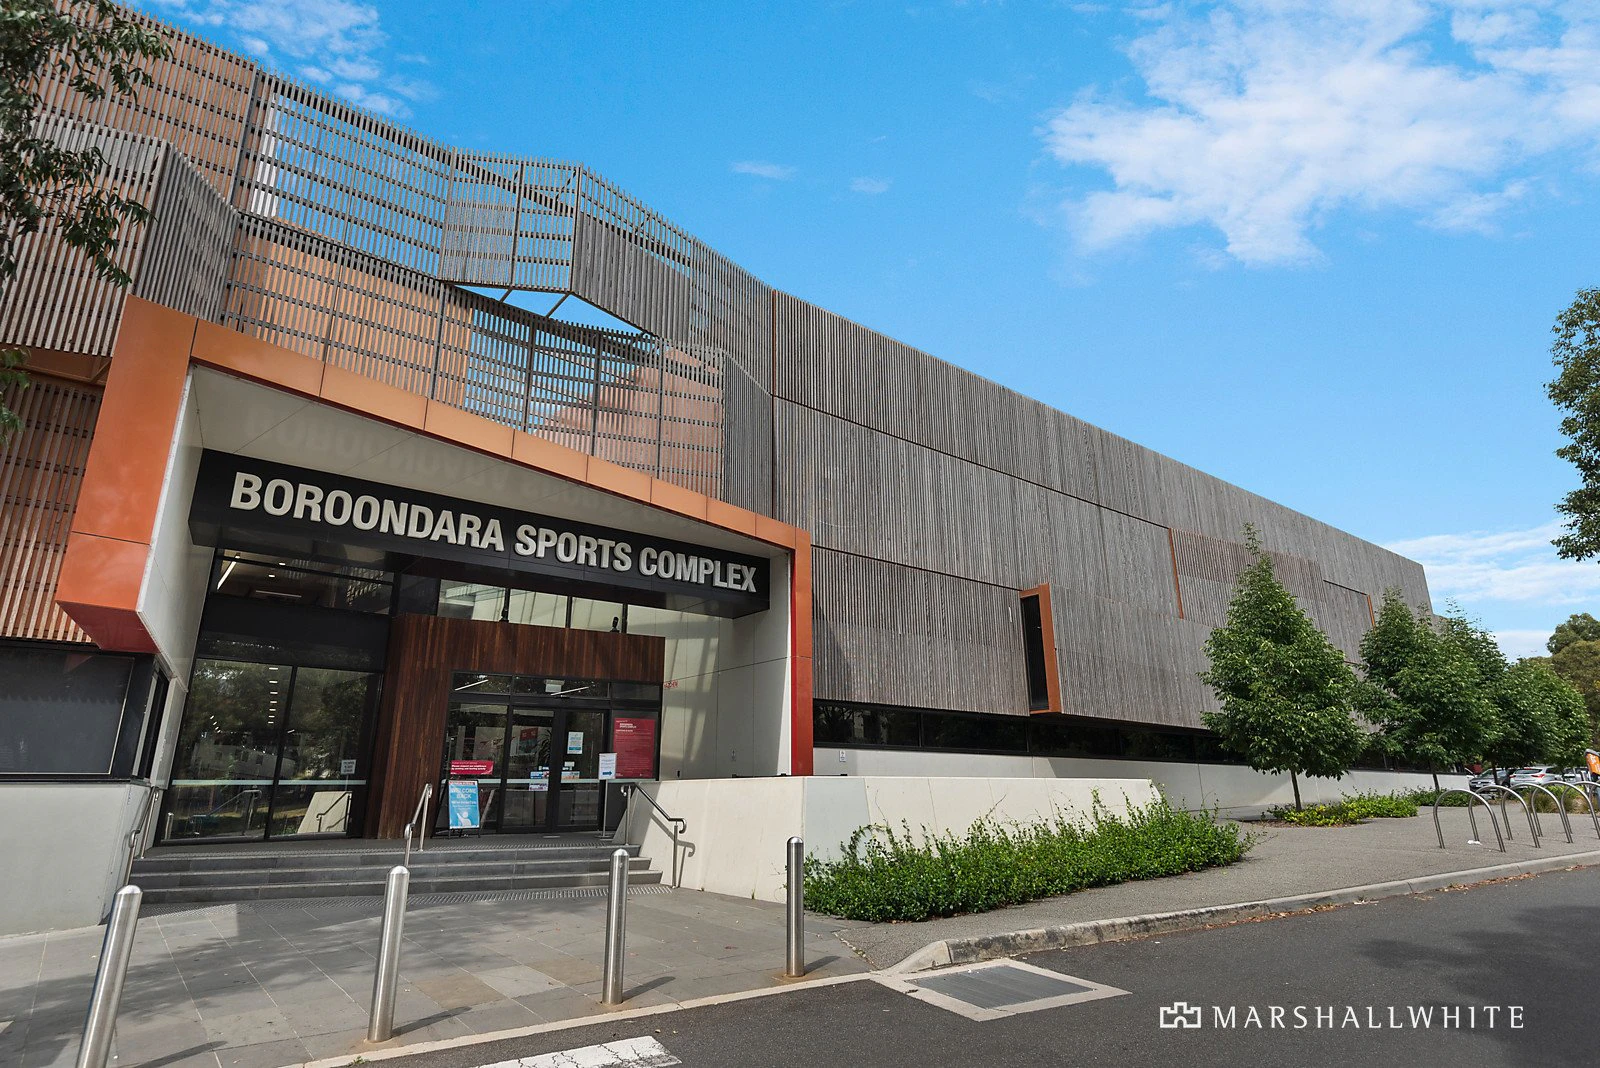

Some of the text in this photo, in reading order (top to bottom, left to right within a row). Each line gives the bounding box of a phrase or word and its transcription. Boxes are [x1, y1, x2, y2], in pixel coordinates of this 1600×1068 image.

[229, 471, 757, 593] BOROONDARA SPORTS COMPLEX
